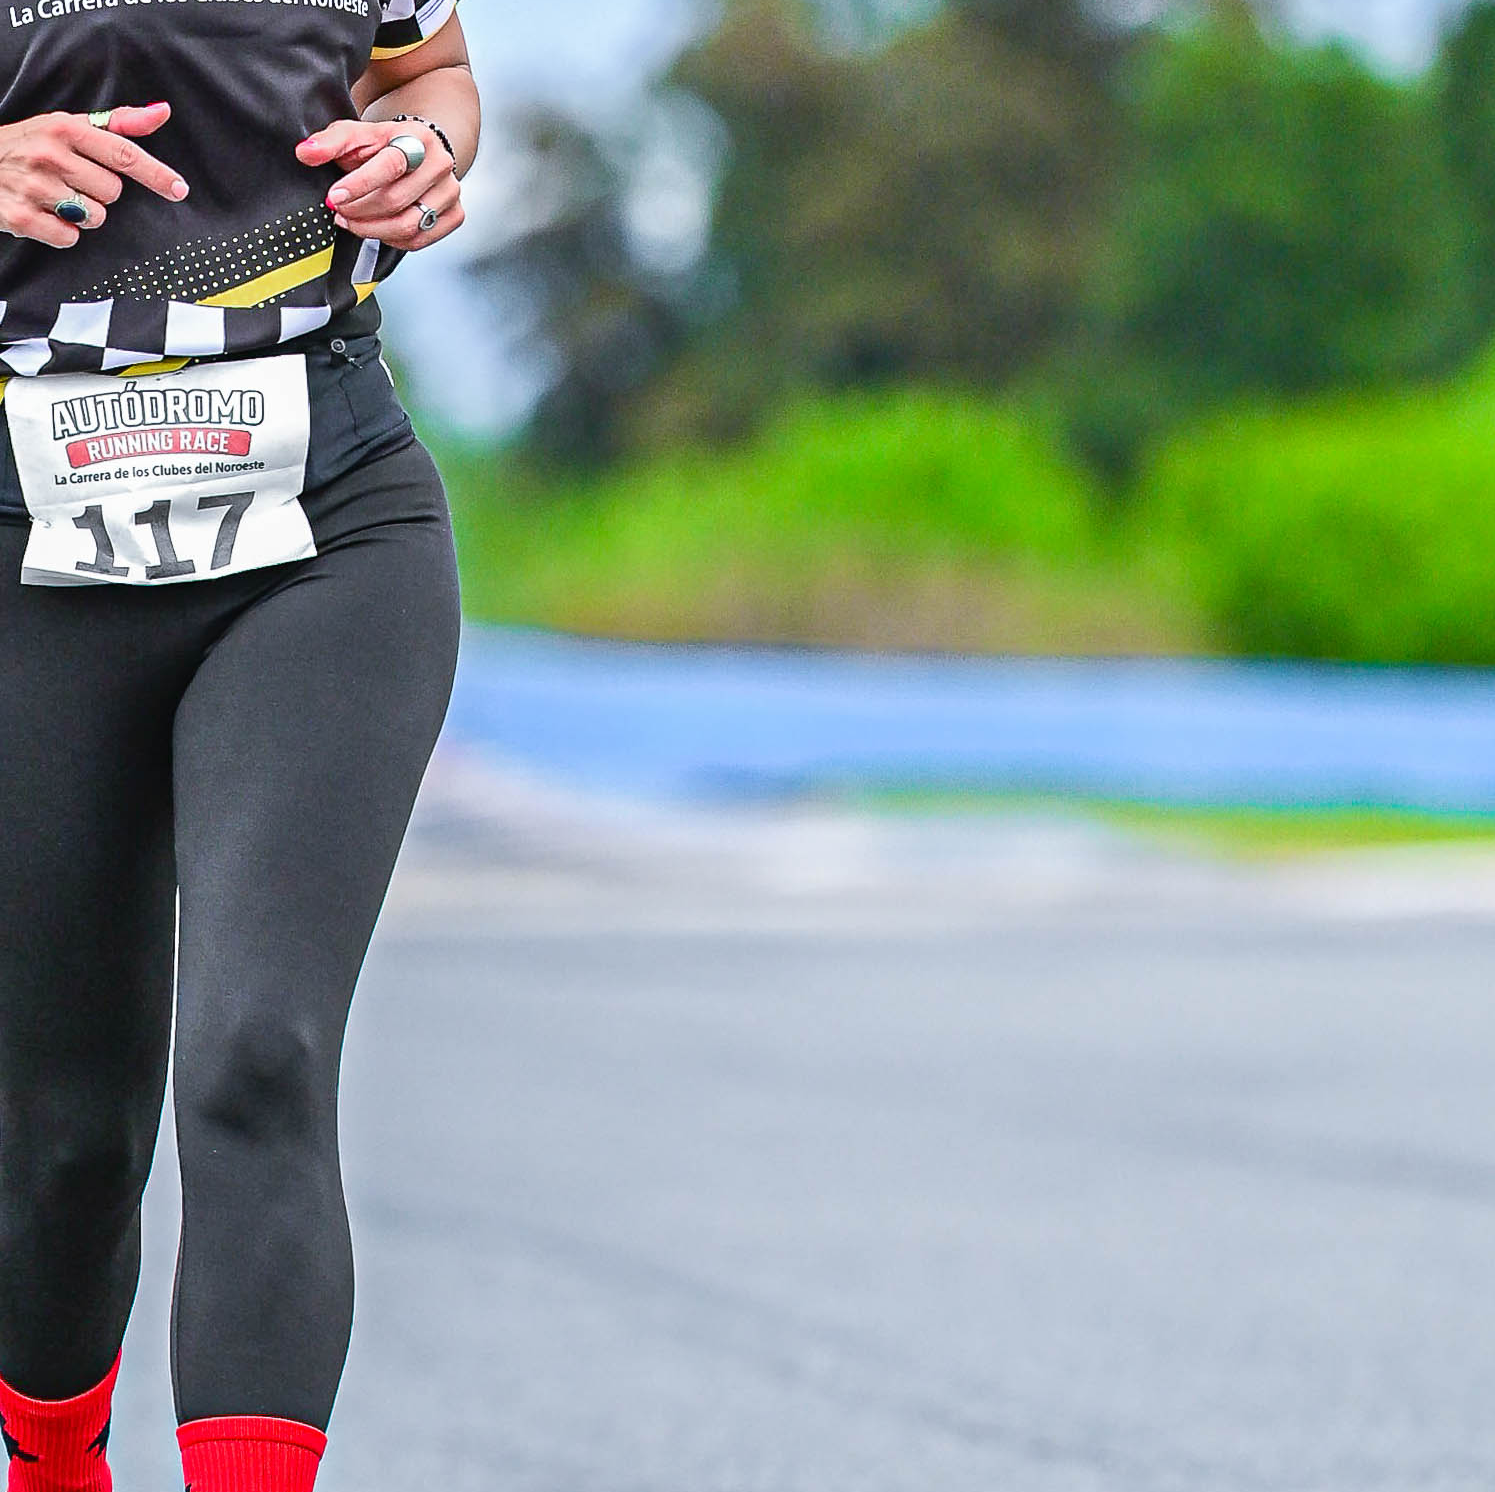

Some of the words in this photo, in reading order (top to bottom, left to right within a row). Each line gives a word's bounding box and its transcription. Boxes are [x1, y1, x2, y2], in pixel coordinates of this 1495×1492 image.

[9, 6, 34, 28] La
[52, 381, 264, 440] AUTÓDROMO
[85, 430, 173, 462] RUNNING
[180, 430, 229, 453] RACE
[54, 474, 67, 486] La
[69, 468, 111, 484] Carrera
[114, 467, 129, 479] de
[132, 466, 150, 478] los
[152, 463, 192, 477] Clubes
[194, 462, 213, 475] del
[215, 460, 265, 473] Noroeste
[72, 491, 256, 580] 117
